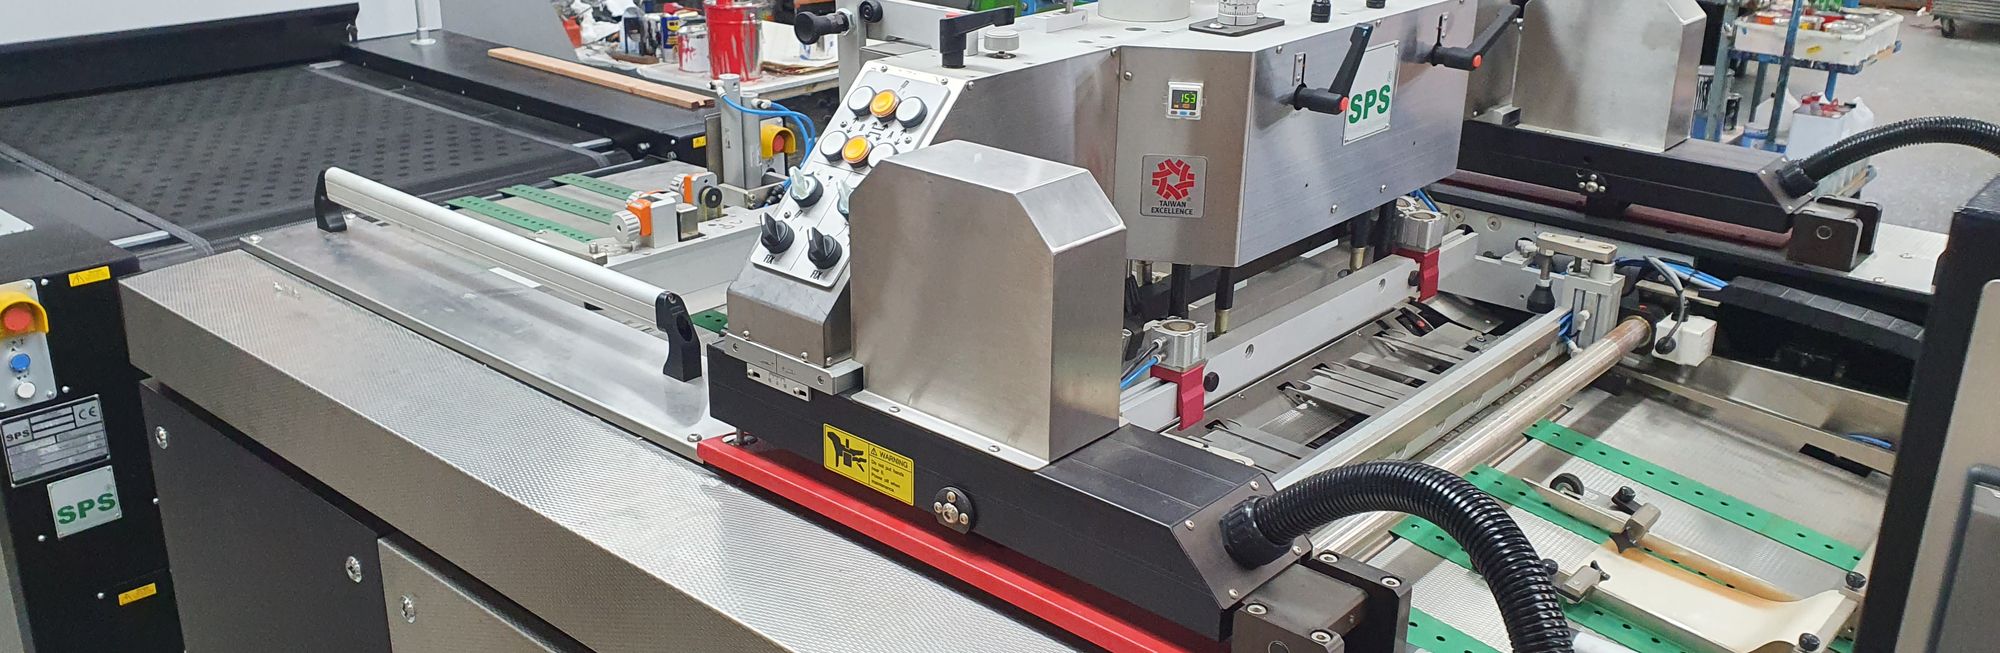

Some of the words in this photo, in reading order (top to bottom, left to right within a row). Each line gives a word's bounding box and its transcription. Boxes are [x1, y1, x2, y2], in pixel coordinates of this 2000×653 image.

[1181, 93, 1196, 104] 153
[1348, 84, 1391, 124] SPS
[1159, 200, 1187, 208] TAIWAN
[1151, 206, 1193, 216] EXCELLENCE
[763, 254, 775, 264] FIX
[810, 270, 823, 280] FIX
[5, 429, 30, 442] SPS
[879, 451, 908, 469] WARNING
[57, 493, 116, 525] SPS
